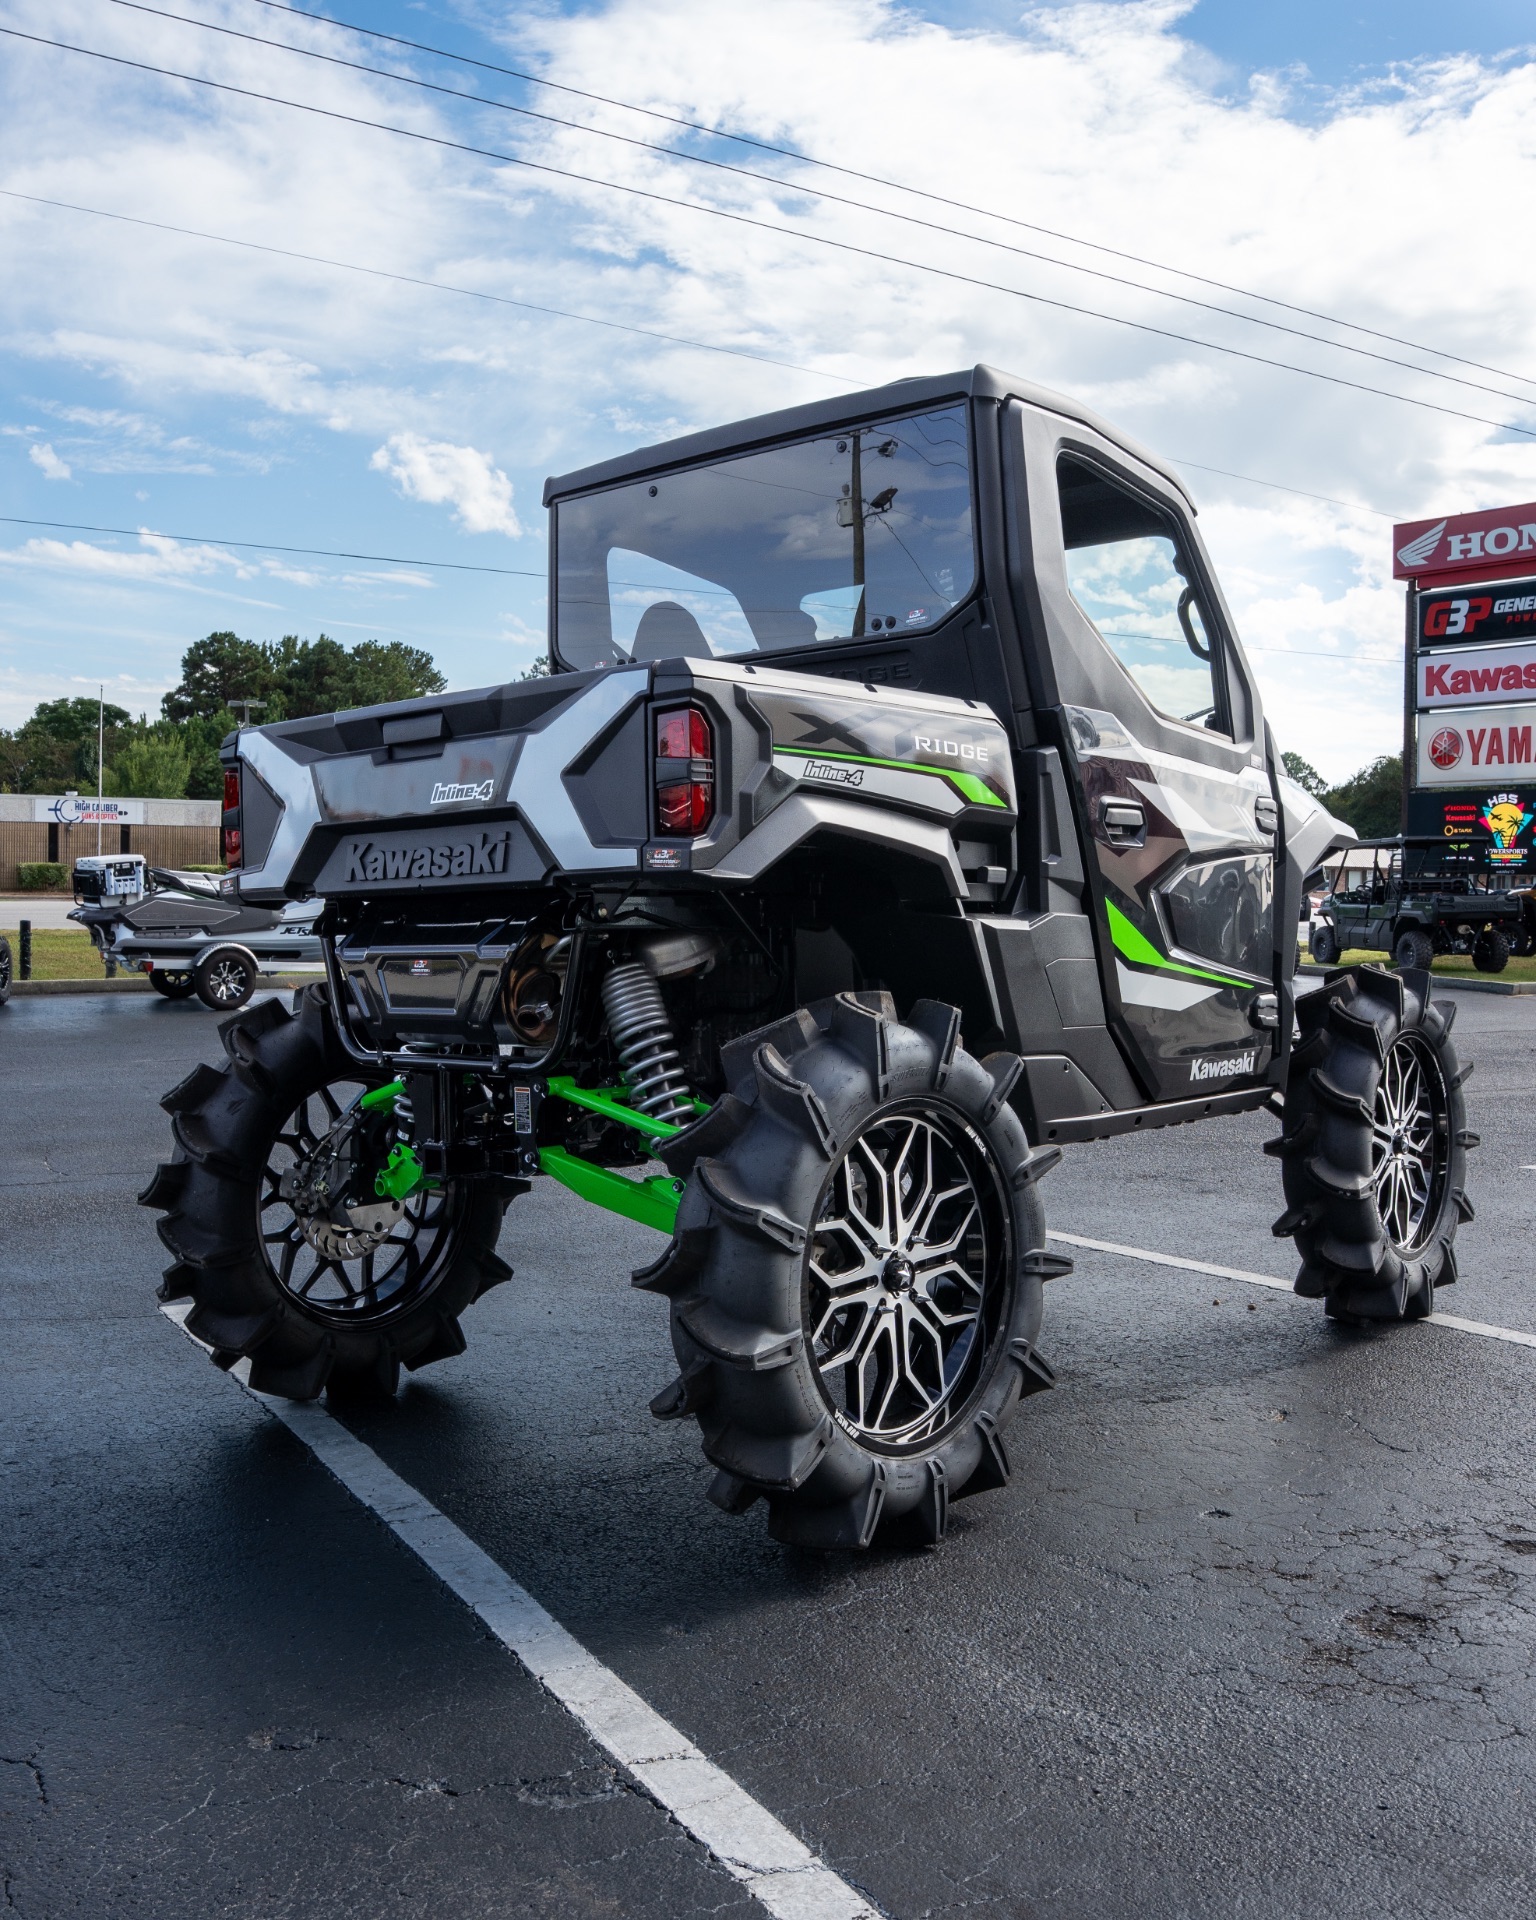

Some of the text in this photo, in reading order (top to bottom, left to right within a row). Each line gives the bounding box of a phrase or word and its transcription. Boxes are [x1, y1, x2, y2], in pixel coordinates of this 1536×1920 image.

[1425, 663, 1536, 697] Kawas
[914, 735, 989, 762] RIDGE
[1466, 726, 1536, 766] YAM
[803, 760, 865, 786] Inline-4
[430, 779, 494, 804] Inline-4
[1487, 793, 1519, 807] HBS
[74, 802, 90, 811] HIGH
[1446, 814, 1476, 822] Kawasaki
[344, 831, 510, 883] Kawasaki
[1189, 1051, 1255, 1081] Kawasaki
